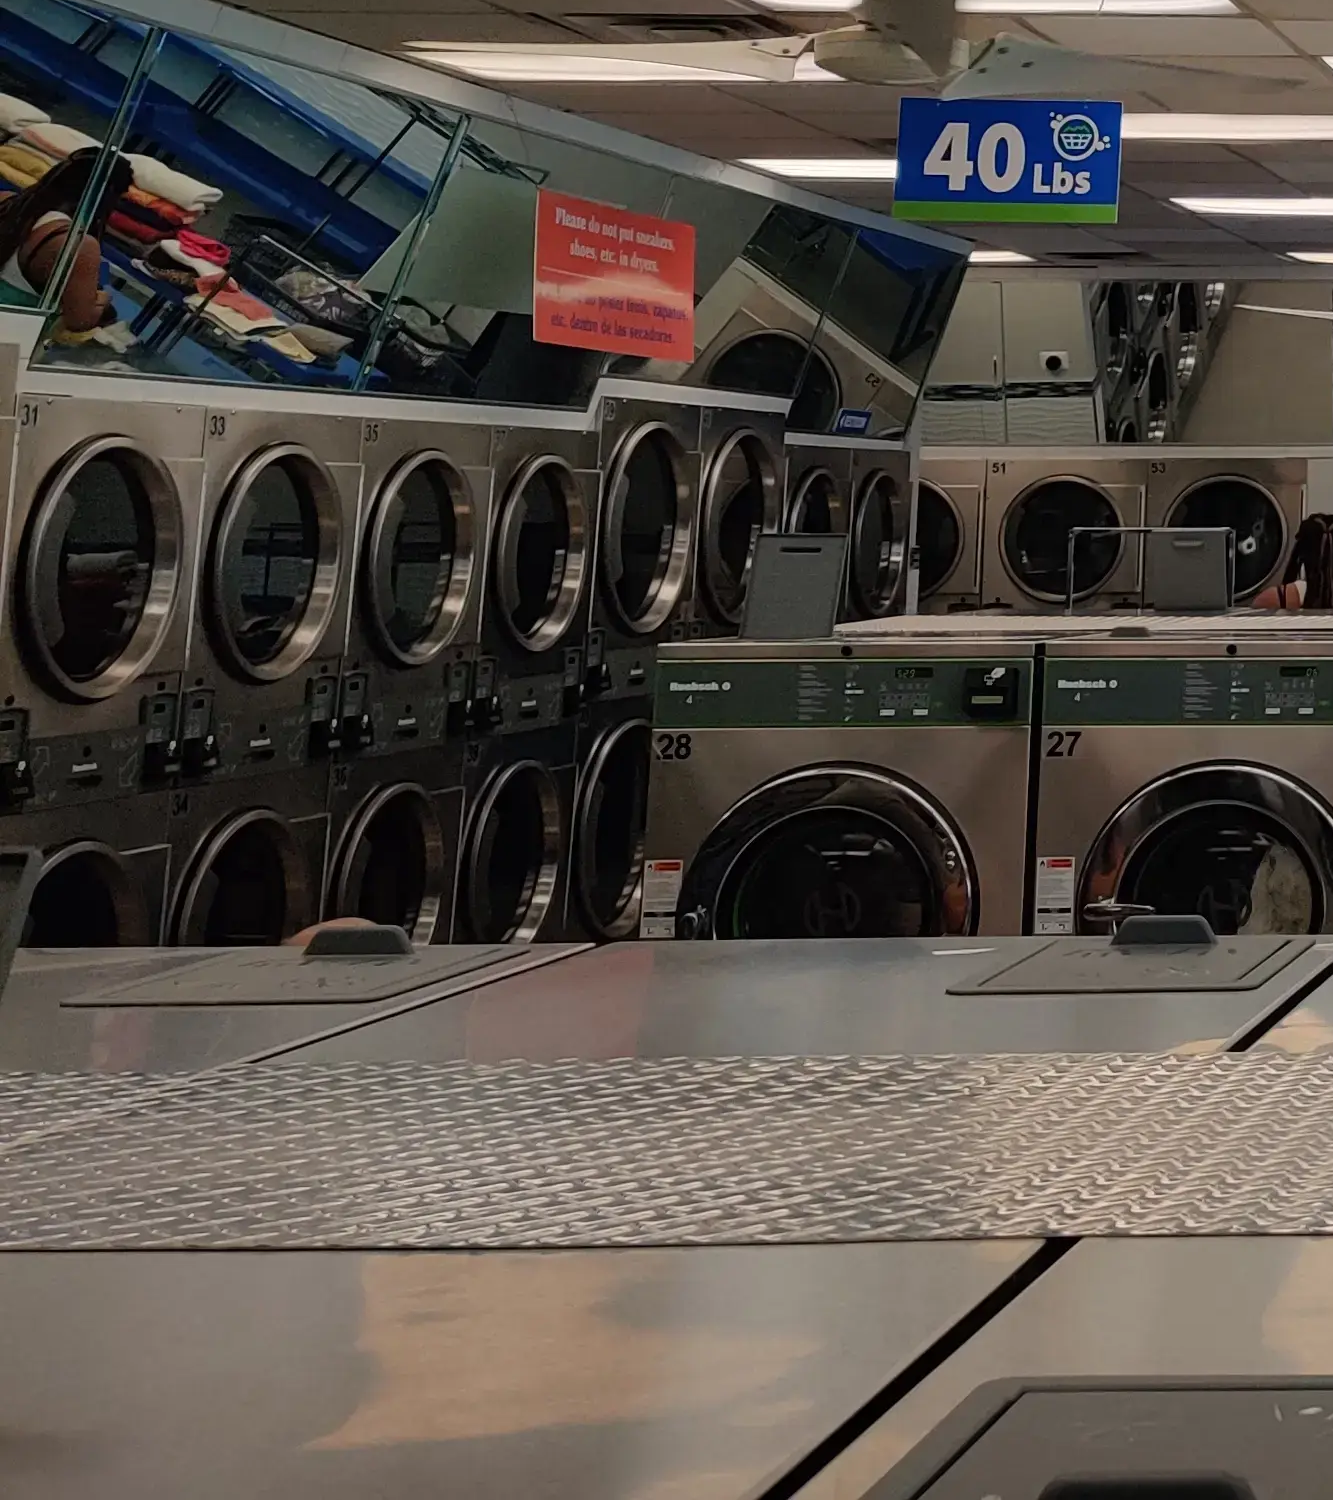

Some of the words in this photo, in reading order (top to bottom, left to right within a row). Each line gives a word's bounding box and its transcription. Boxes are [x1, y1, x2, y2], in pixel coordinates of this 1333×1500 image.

[923, 122, 1026, 194] 40
[1032, 162, 1092, 195] Lbs
[555, 206, 587, 230] Please
[588, 215, 600, 234] do
[602, 223, 618, 240] not
[619, 227, 635, 244] put
[619, 250, 628, 266] in
[21, 404, 38, 426] 31
[210, 416, 226, 436] 33
[364, 424, 379, 442] 35
[992, 462, 1006, 474] 51
[1151, 462, 1166, 474] 53
[657, 733, 692, 760] 28
[1046, 731, 1082, 757] 27
[172, 794, 188, 815] 34
